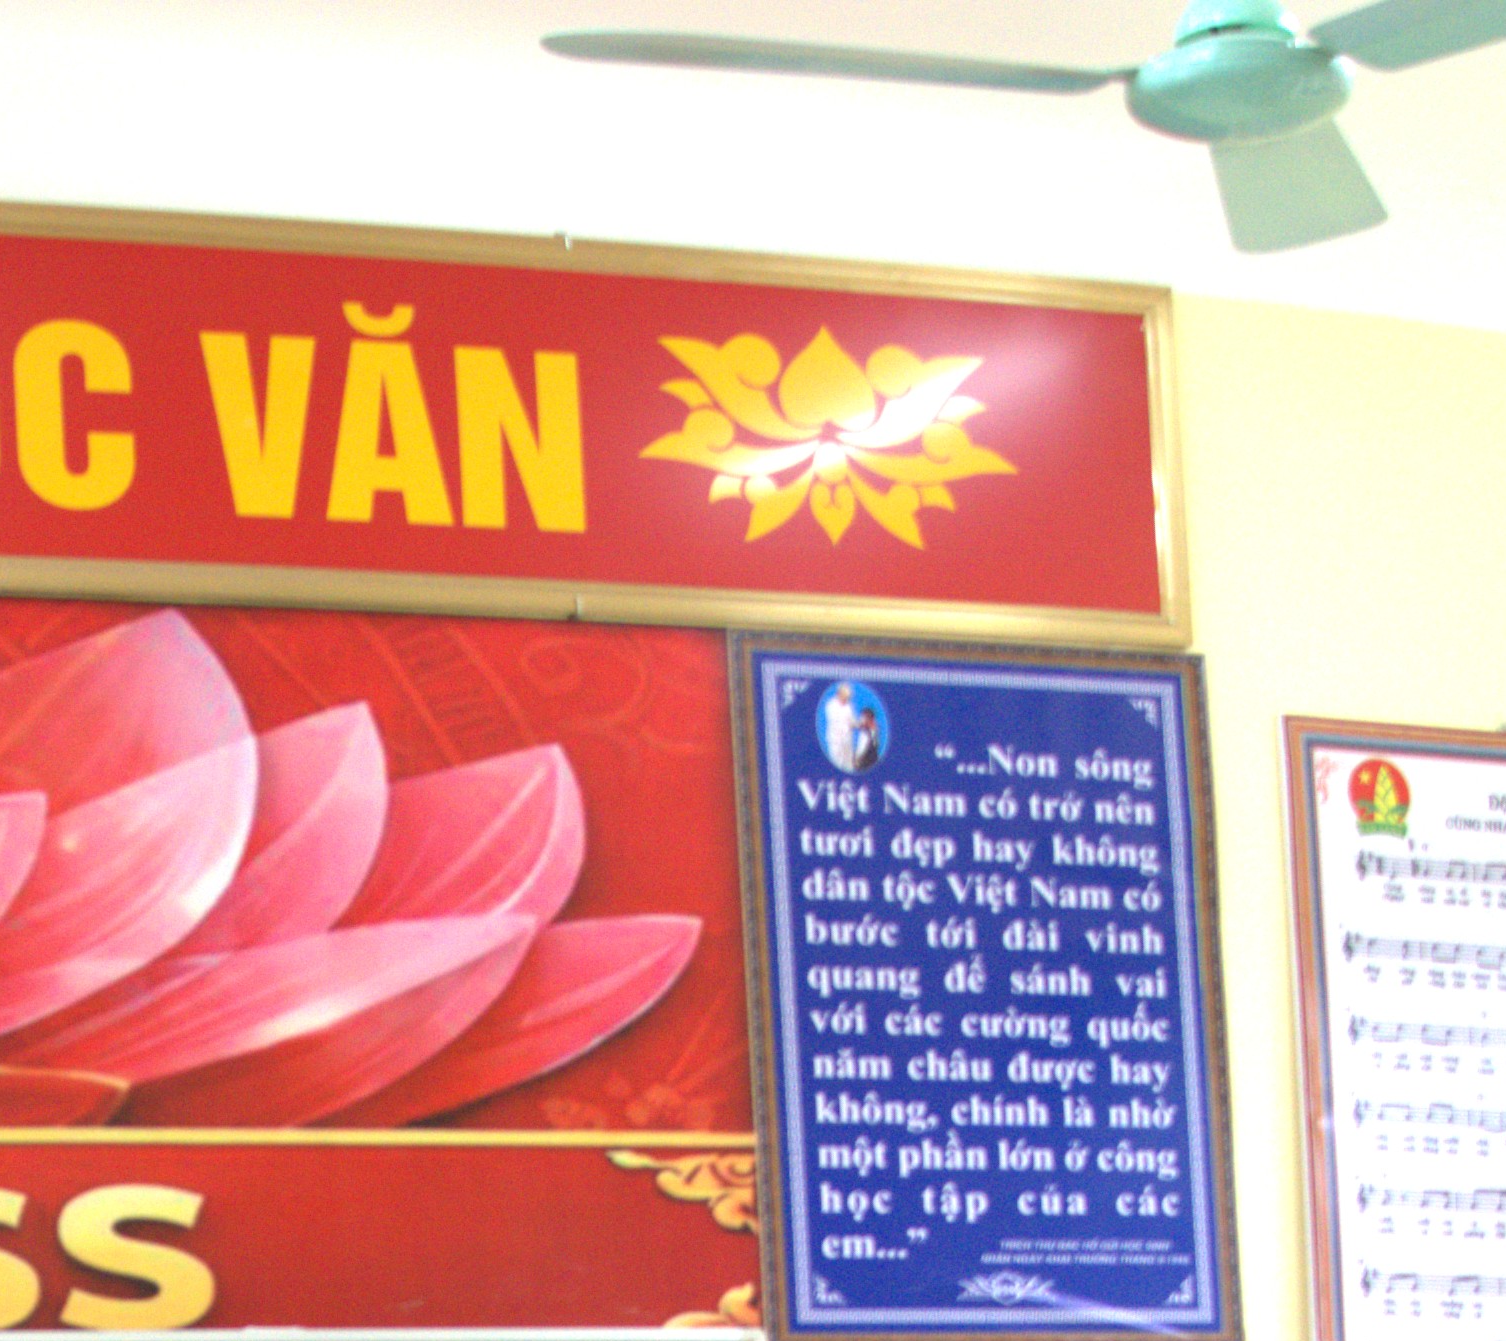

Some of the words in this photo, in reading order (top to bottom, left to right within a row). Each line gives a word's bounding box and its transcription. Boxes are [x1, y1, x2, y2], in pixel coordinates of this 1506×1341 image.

[201, 301, 588, 536] VĂN
[1075, 748, 1153, 789] sông
[798, 778, 870, 821] Việt
[883, 782, 967, 818] Nam
[978, 787, 1017, 819] có
[1095, 792, 1155, 825] nên
[800, 826, 874, 856] tươi
[891, 828, 956, 868] đẹp
[972, 830, 1034, 872] hay
[1052, 834, 1161, 876] không
[802, 867, 870, 901] dân
[882, 870, 936, 911] tộc
[946, 872, 1017, 914] Việt
[1030, 876, 1112, 910] Nam
[1123, 879, 1161, 912] có
[807, 964, 921, 999] quang
[1010, 963, 1092, 996] sánh
[1115, 966, 1168, 998] vai
[810, 1002, 867, 1035] với
[884, 1004, 943, 1036] các
[961, 1006, 1071, 1048] cường
[1087, 1001, 1170, 1048] quốc
[813, 1048, 892, 1080] năm
[907, 1048, 993, 1081] châu
[1007, 1051, 1096, 1091] được
[1110, 1053, 1170, 1093] hay
[818, 1135, 888, 1177] một
[899, 1128, 987, 1178] phần
[998, 1138, 1055, 1171] lớn
[1097, 1139, 1180, 1180] công
[820, 1181, 891, 1222] học
[922, 1181, 988, 1223] tập
[1116, 1185, 1180, 1217] các
